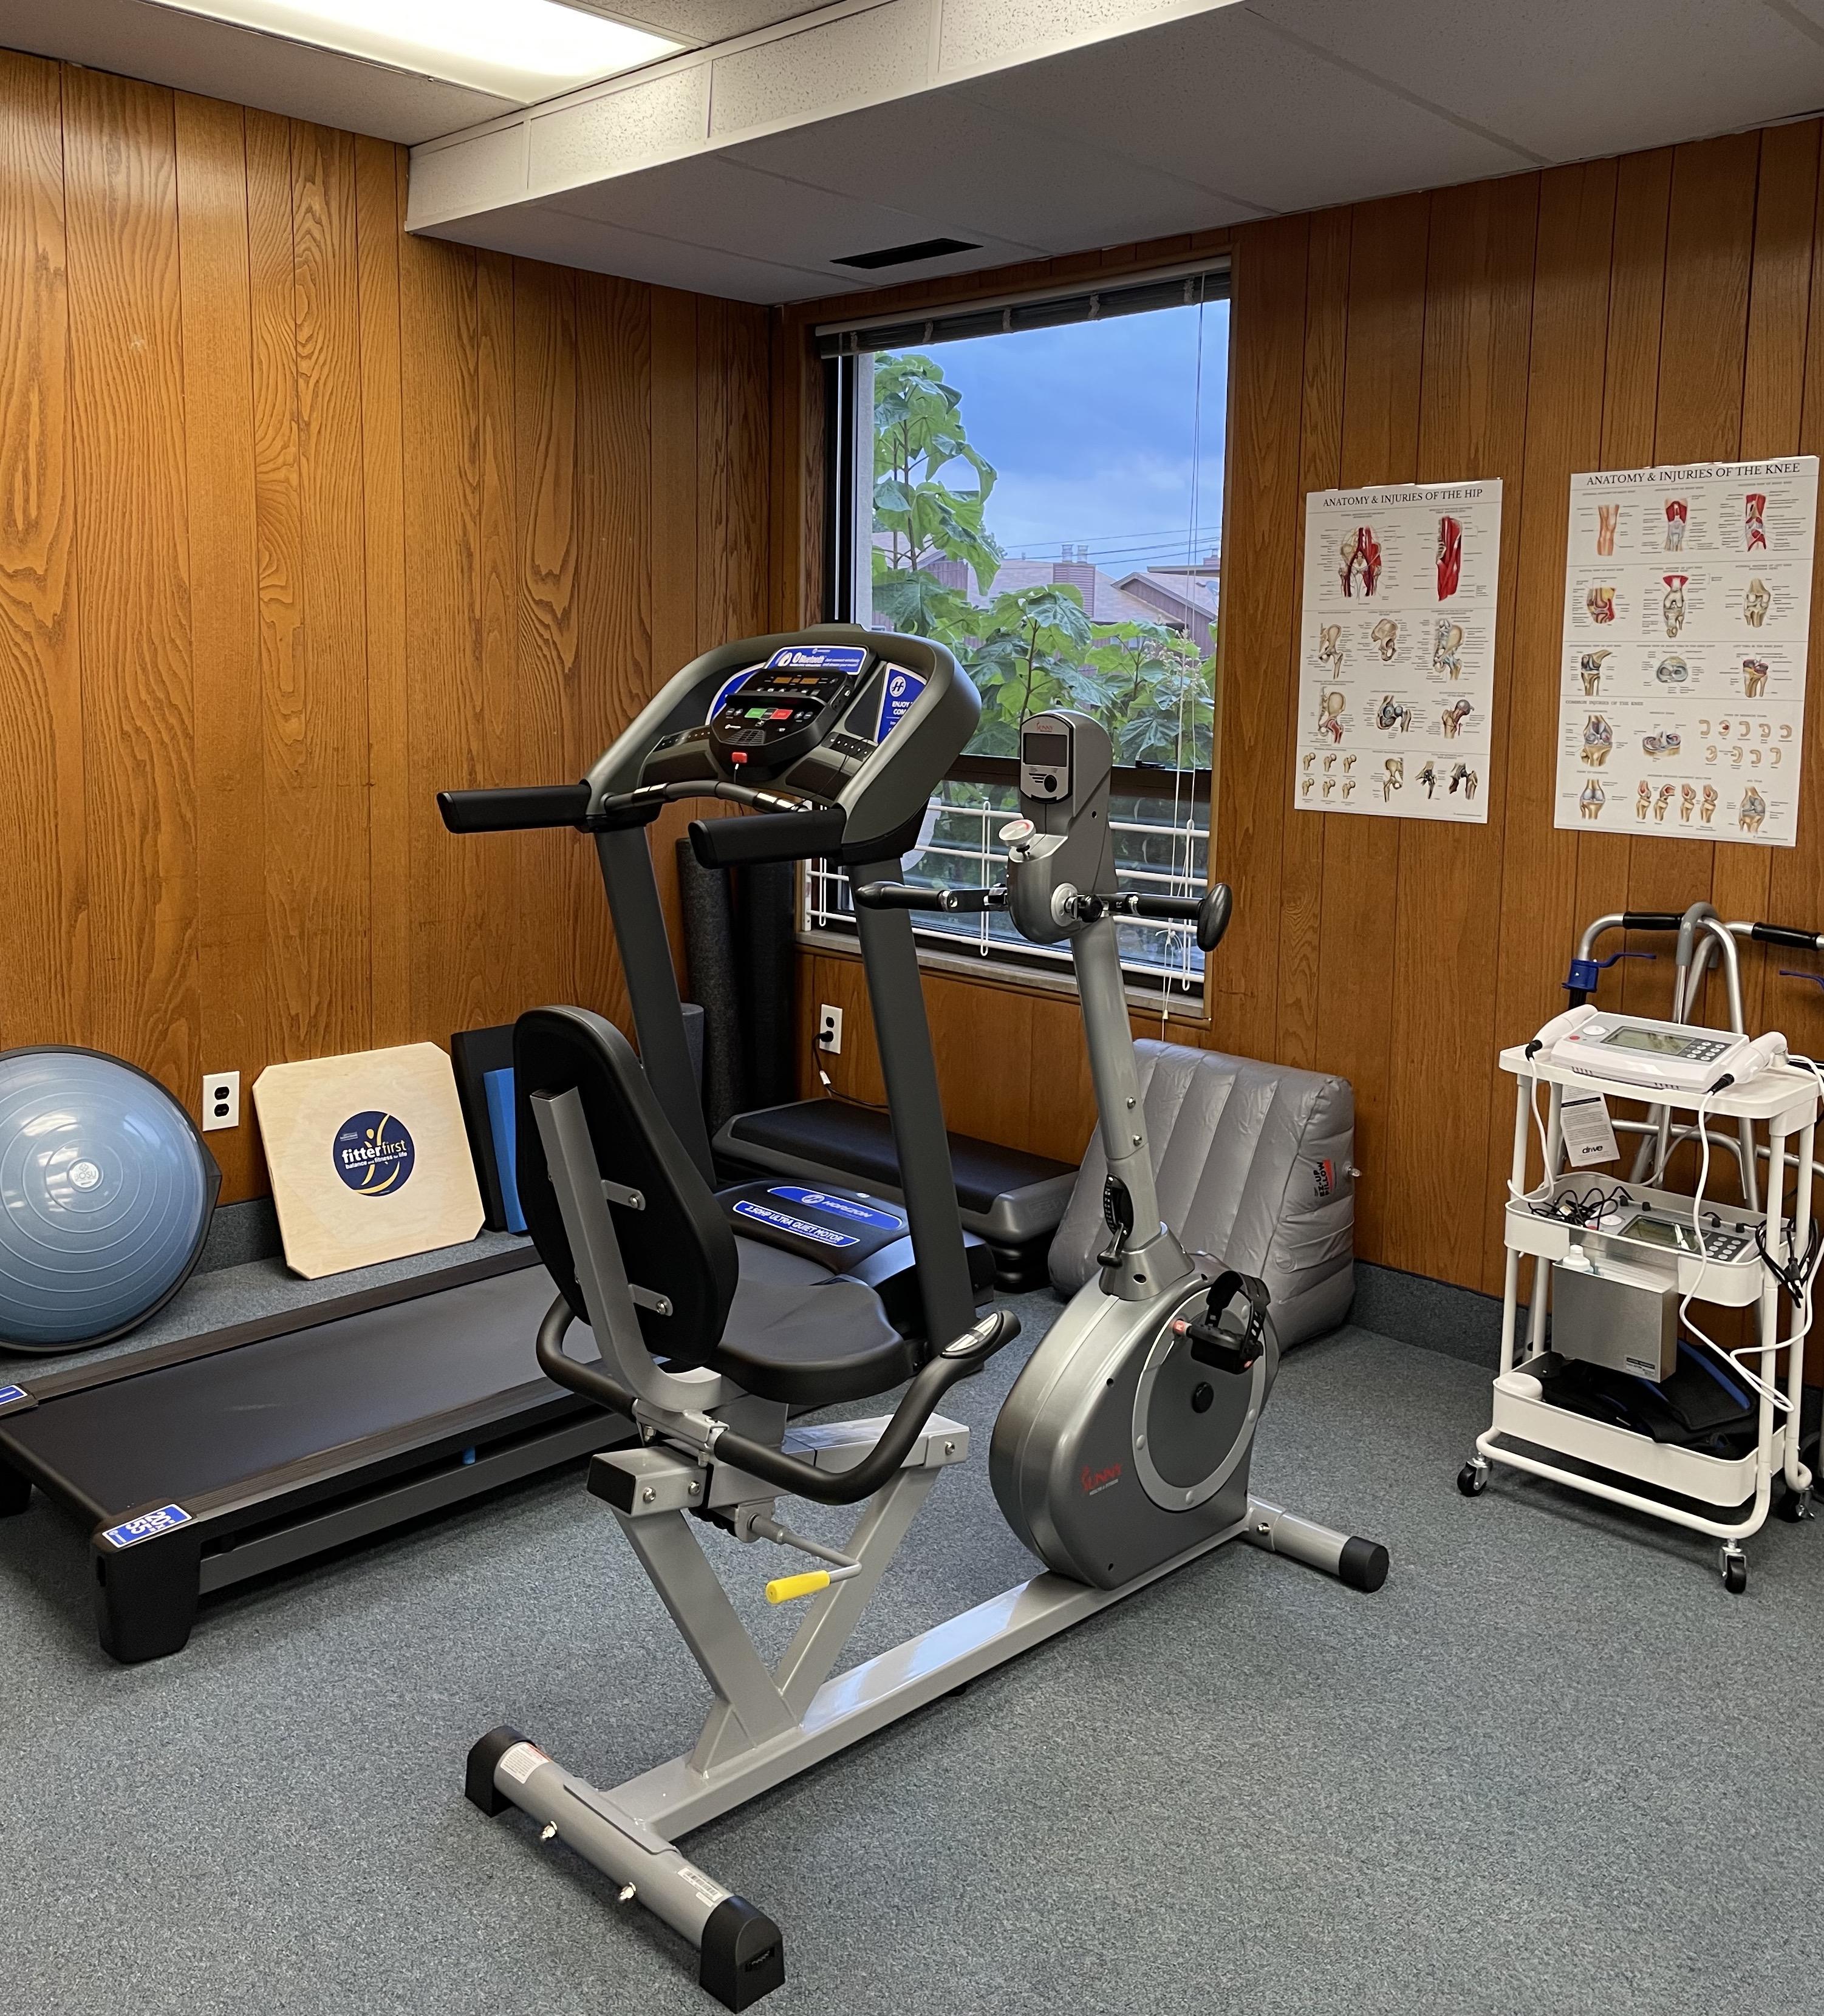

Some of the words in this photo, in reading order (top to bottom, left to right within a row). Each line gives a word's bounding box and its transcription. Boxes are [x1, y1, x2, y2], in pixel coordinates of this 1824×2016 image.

[1587, 472, 1645, 485] ANATOMY
[1647, 472, 1656, 482] &
[1659, 468, 1712, 482] INJURIES
[1716, 467, 1733, 477] OF
[1735, 466, 1762, 476] THE
[1766, 463, 1800, 474] KNEE
[1323, 495, 1370, 507] ANATOMY
[1371, 495, 1378, 504] &
[1381, 492, 1423, 505] INJURIES
[1425, 491, 1440, 501] OF
[1440, 490, 1462, 500] THE
[1464, 489, 1483, 498] HIP
[1582, 1145, 1603, 1154] drive
[345, 1161, 367, 1170] balance
[1313, 1170, 1325, 1197] EZ-UP
[1317, 1162, 1330, 1196] PILLOW
[821, 1201, 873, 1217] HORIZON
[769, 1213, 793, 1225] ULTRA
[791, 1221, 818, 1233] QUIET
[815, 1229, 844, 1242] MOTOR
